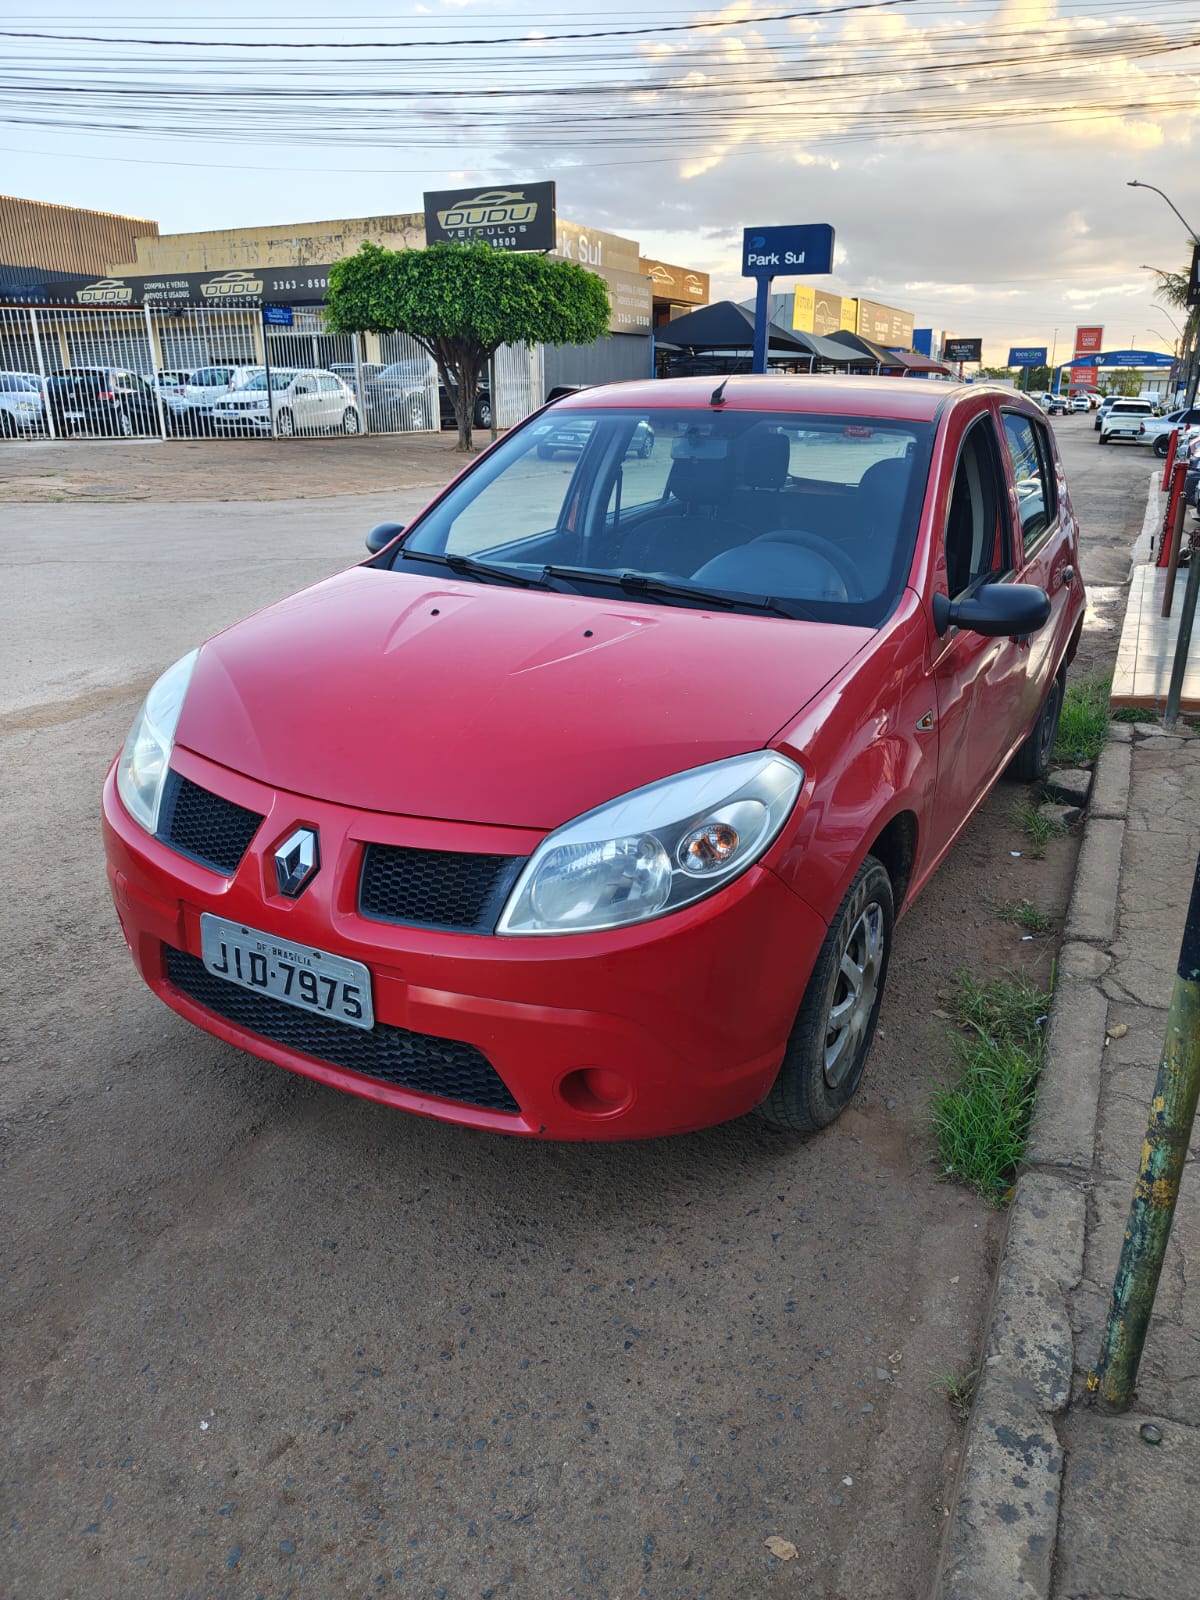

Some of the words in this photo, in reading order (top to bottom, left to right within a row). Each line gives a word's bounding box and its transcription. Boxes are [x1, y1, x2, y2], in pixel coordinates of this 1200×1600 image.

[444, 206, 531, 226] DUDU
[447, 225, 527, 238] VEÍCULOS
[492, 237, 516, 247] 8500
[578, 234, 602, 266] Sul
[747, 252, 779, 267] Park
[784, 251, 805, 264] Sul
[205, 282, 258, 295] DUDU
[273, 280, 297, 290] 3363
[81, 290, 128, 301] DUDU
[256, 941, 267, 951] DF
